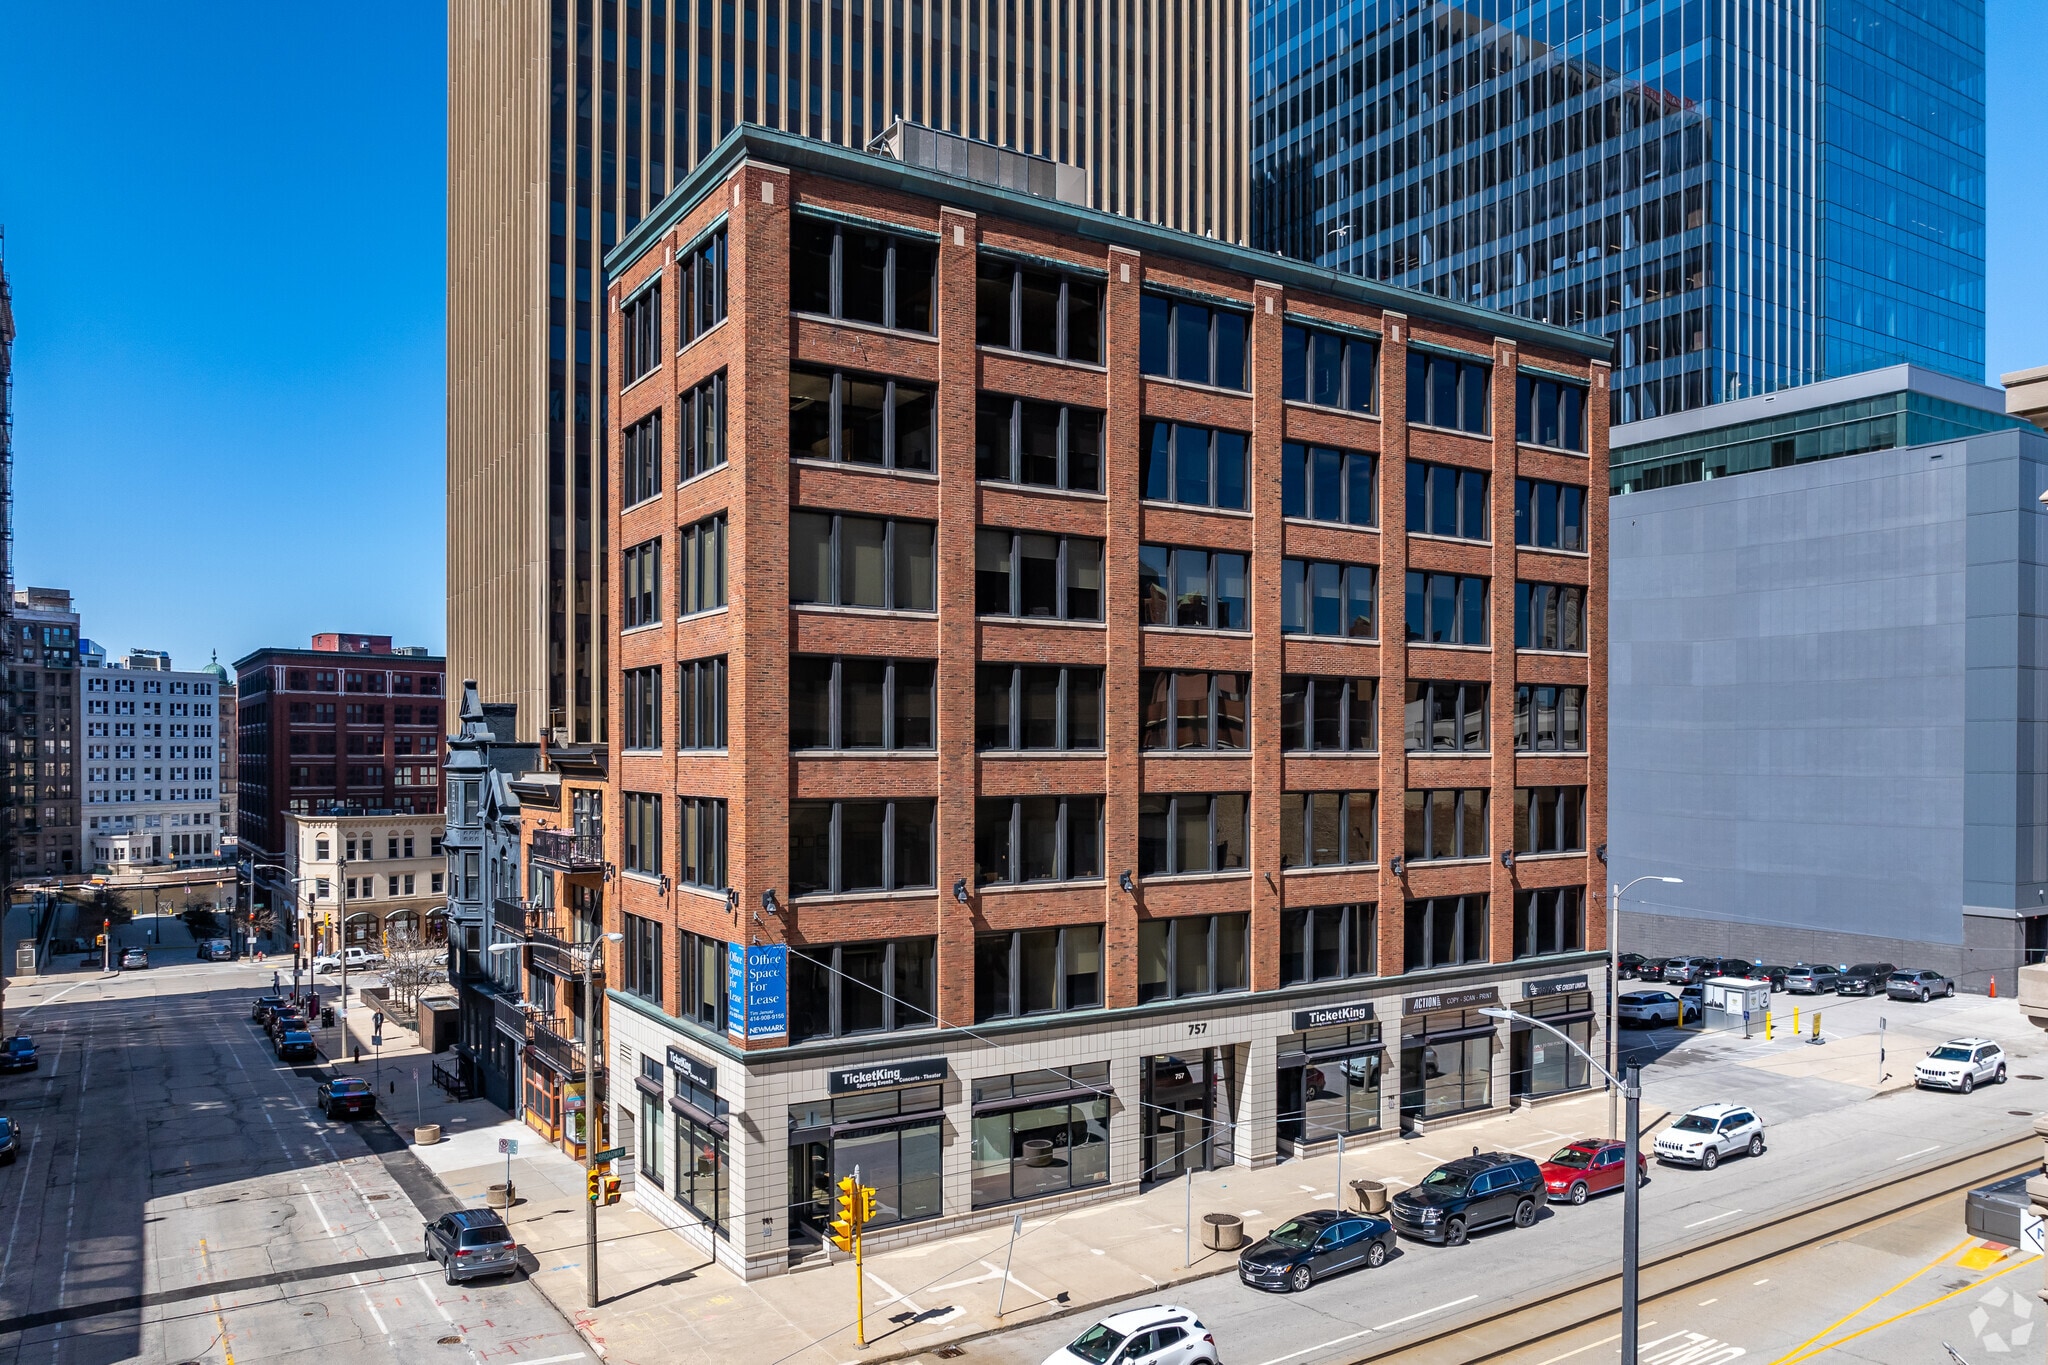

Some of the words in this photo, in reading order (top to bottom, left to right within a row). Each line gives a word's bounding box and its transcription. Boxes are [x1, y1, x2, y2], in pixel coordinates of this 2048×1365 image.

[750, 954, 781, 966] Office
[750, 968, 780, 982] Space
[750, 982, 768, 992] For
[750, 995, 780, 1006] Lease
[1413, 996, 1437, 1010] ACTION
[1446, 997, 1459, 1005] COPY
[1463, 995, 1476, 1003] SCAN
[1309, 1007, 1366, 1023] TicketKing
[750, 1024, 785, 1034] NEWMARK
[1188, 1022, 1207, 1036] 757
[842, 1069, 901, 1085] TicketKing
[899, 1075, 920, 1083] Concerts
[1174, 1072, 1185, 1080] 757
[856, 1080, 877, 1090] Sporting
[877, 1079, 894, 1087] Events
[598, 1148, 624, 1161] BROADWAY
